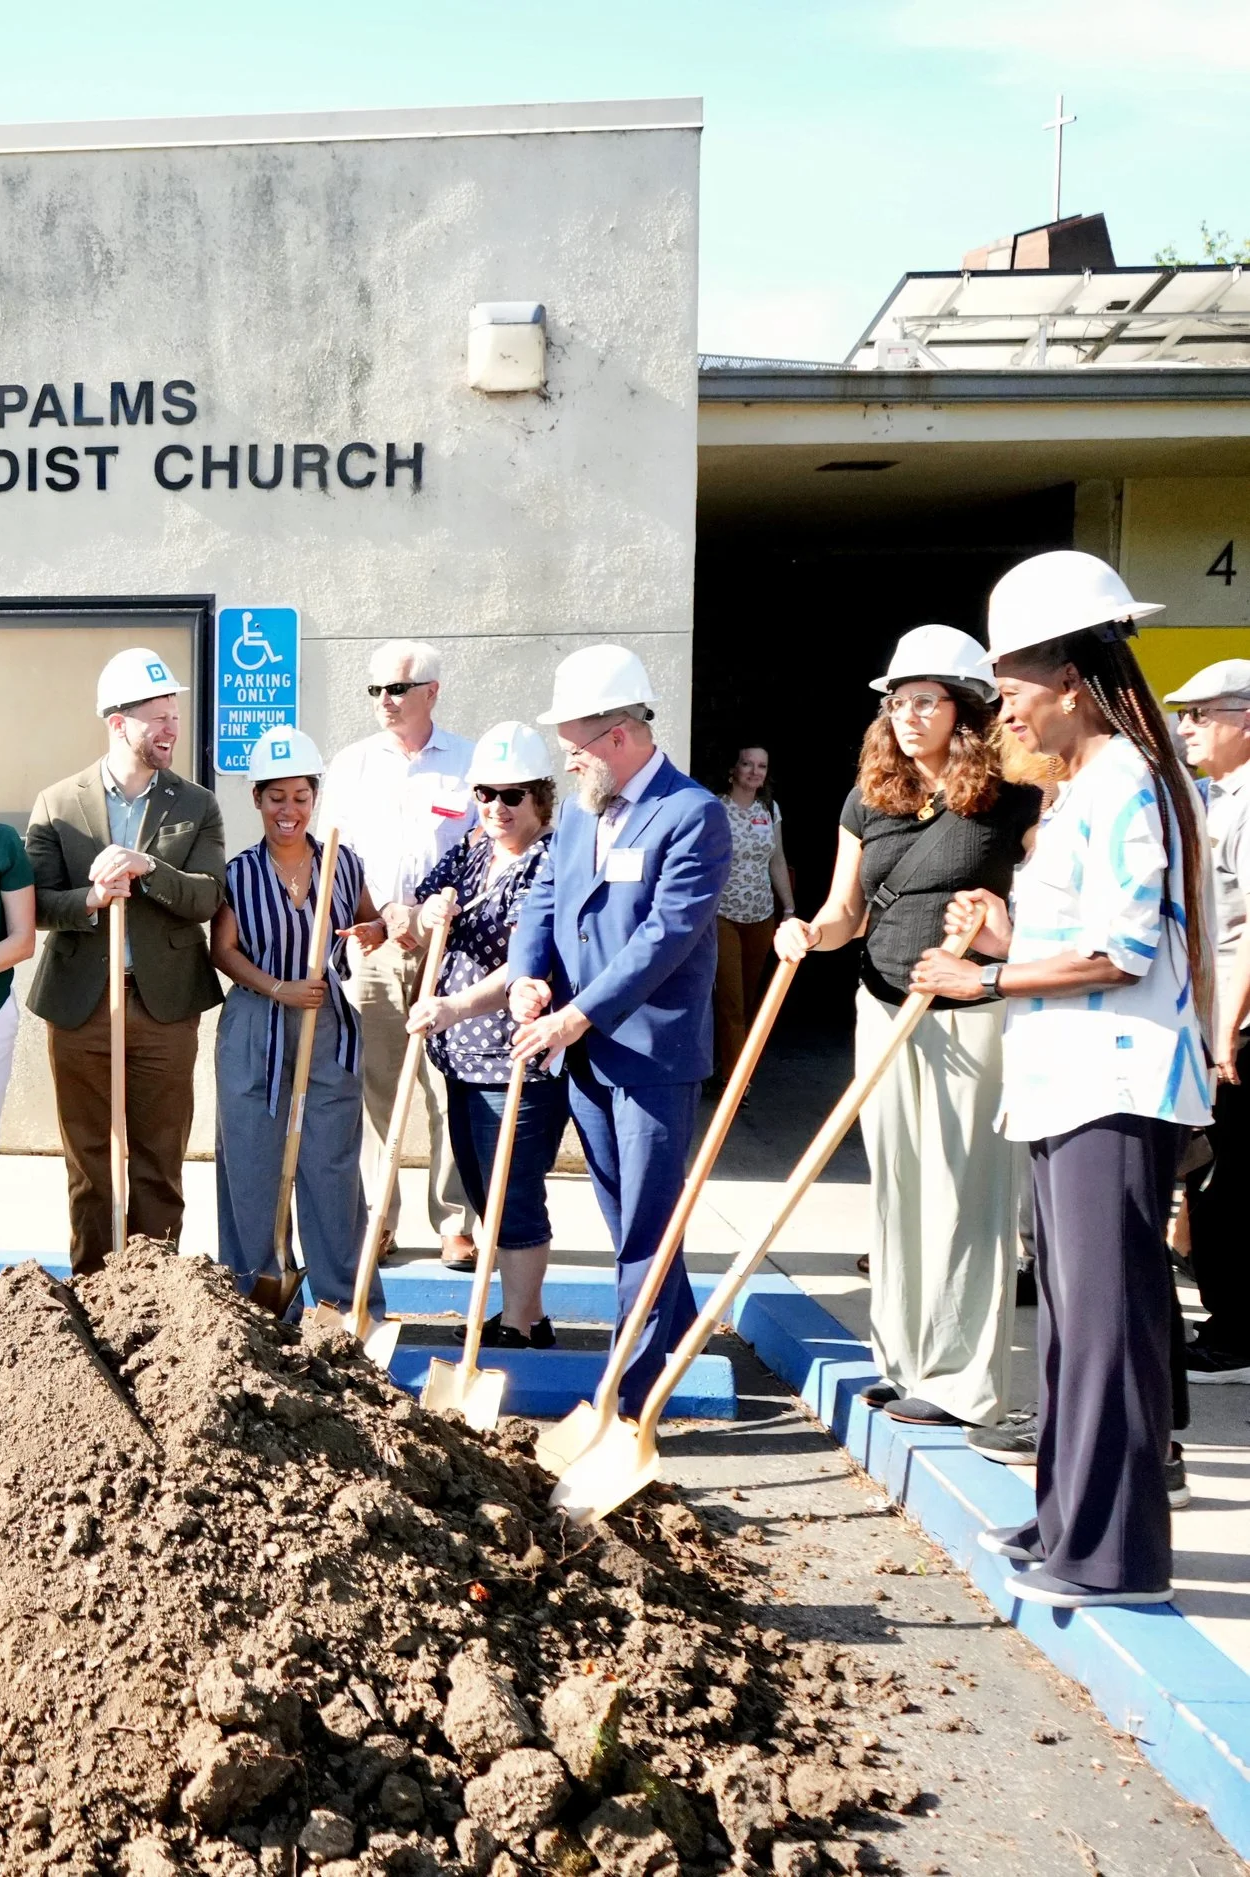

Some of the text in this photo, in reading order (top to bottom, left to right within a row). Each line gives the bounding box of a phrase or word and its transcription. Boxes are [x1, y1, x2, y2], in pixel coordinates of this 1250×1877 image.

[155, 443, 423, 490] CHURCH
[1206, 539, 1237, 586] 4
[223, 674, 291, 687] PARKING
[237, 688, 277, 702] ONLY
[228, 710, 286, 723] MINIMUM
[220, 723, 249, 736] FINE
